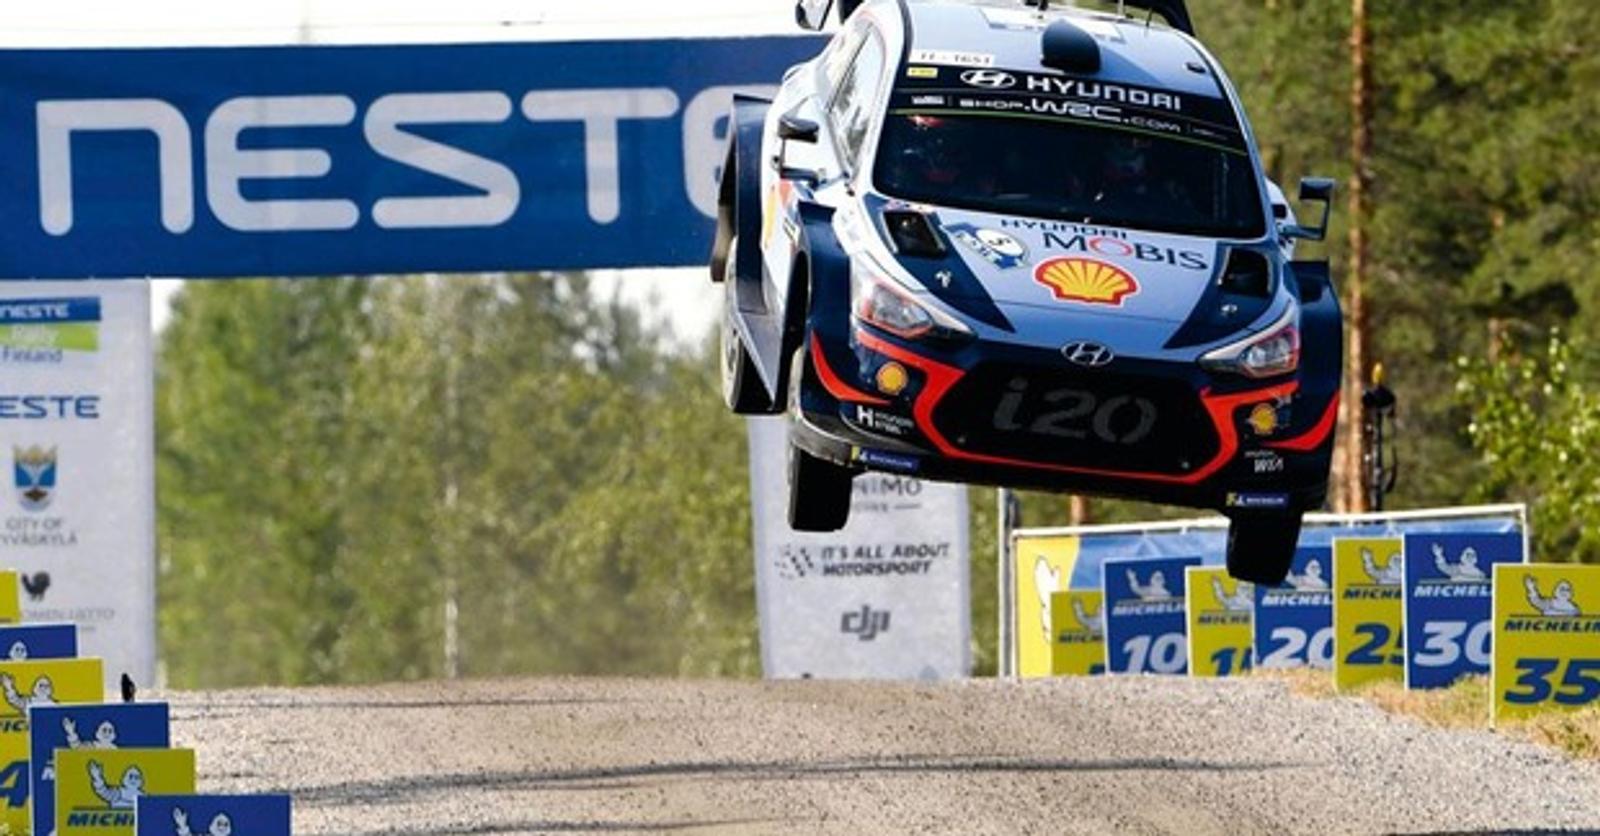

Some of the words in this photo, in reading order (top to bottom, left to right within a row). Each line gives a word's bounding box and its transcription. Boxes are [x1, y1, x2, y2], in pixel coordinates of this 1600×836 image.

[1027, 75, 1181, 110] HYUNDAI
[1001, 218, 1127, 239] HYUNDAI
[1043, 232, 1208, 271] MOBIS
[993, 376, 1158, 445] i20
[6, 517, 39, 531] CITY
[43, 517, 63, 531] OF
[823, 560, 933, 577] MOTORSPORT
[854, 545, 884, 559] ALL
[891, 543, 950, 559] ABOUT
[1122, 632, 1187, 674] 10
[1504, 658, 1600, 705] 35
